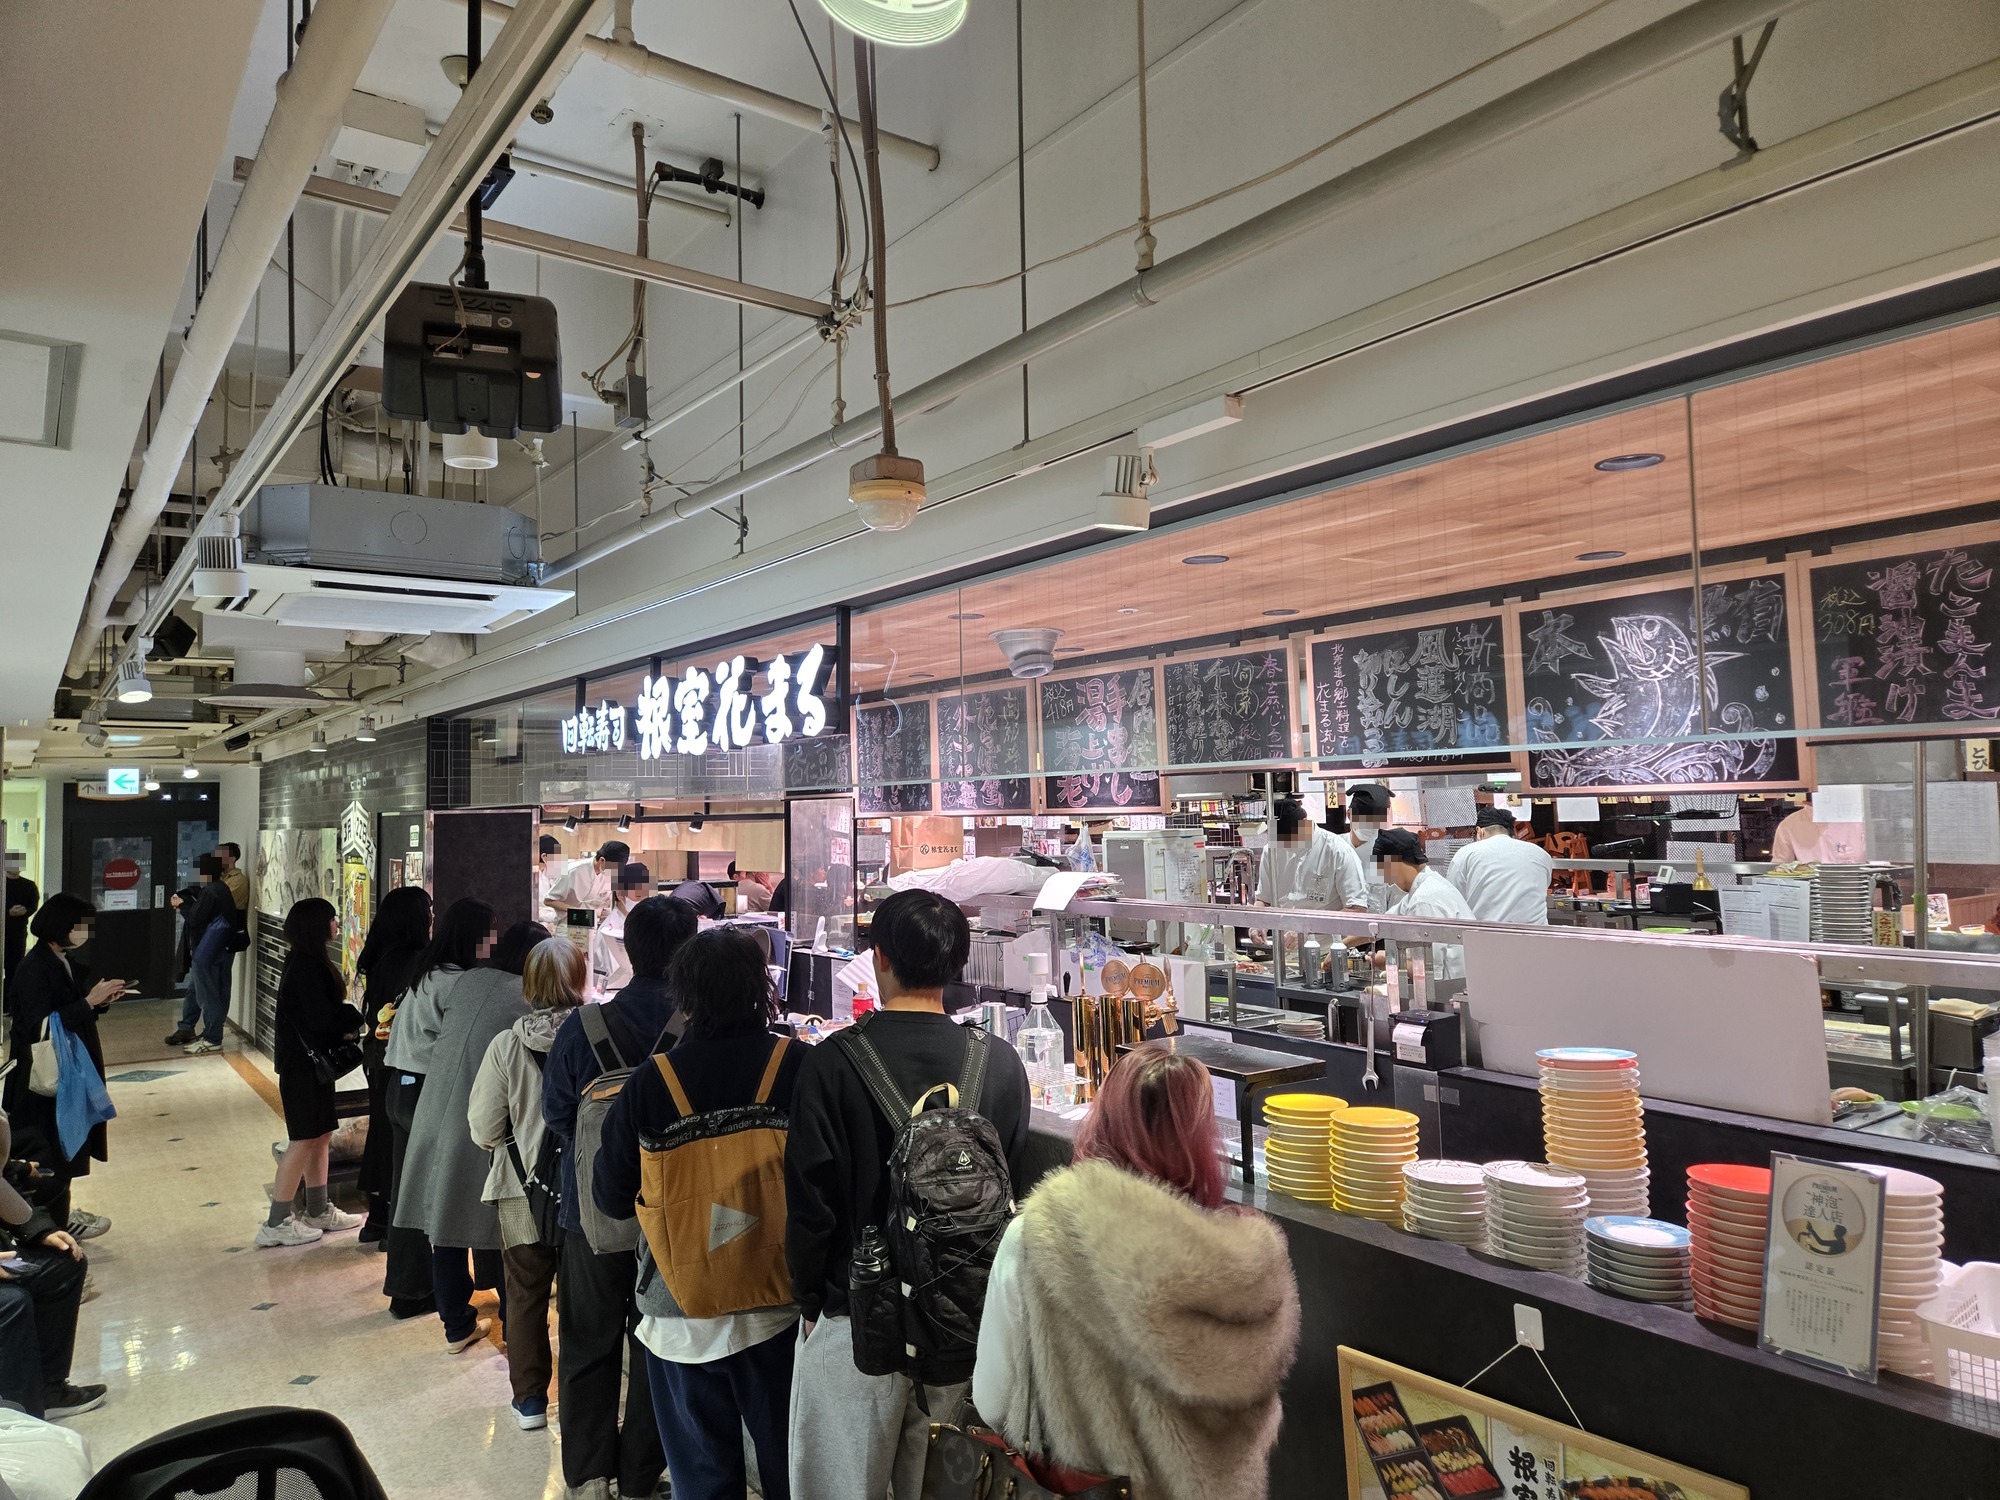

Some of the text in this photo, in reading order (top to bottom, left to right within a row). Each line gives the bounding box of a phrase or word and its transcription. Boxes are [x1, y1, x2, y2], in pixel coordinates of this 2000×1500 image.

[636, 643, 826, 760] 根室花まる
[1331, 643, 1350, 749] 北海道の郷土料理を
[1408, 627, 1460, 745] 風蓮湖
[562, 699, 625, 754] 回転寿司
[1972, 746, 1988, 770] とび
[1134, 977, 1160, 986] PREMIUM
[1812, 1181, 1838, 1194] PREMIUM
[1803, 1204, 1844, 1225] 達人店
